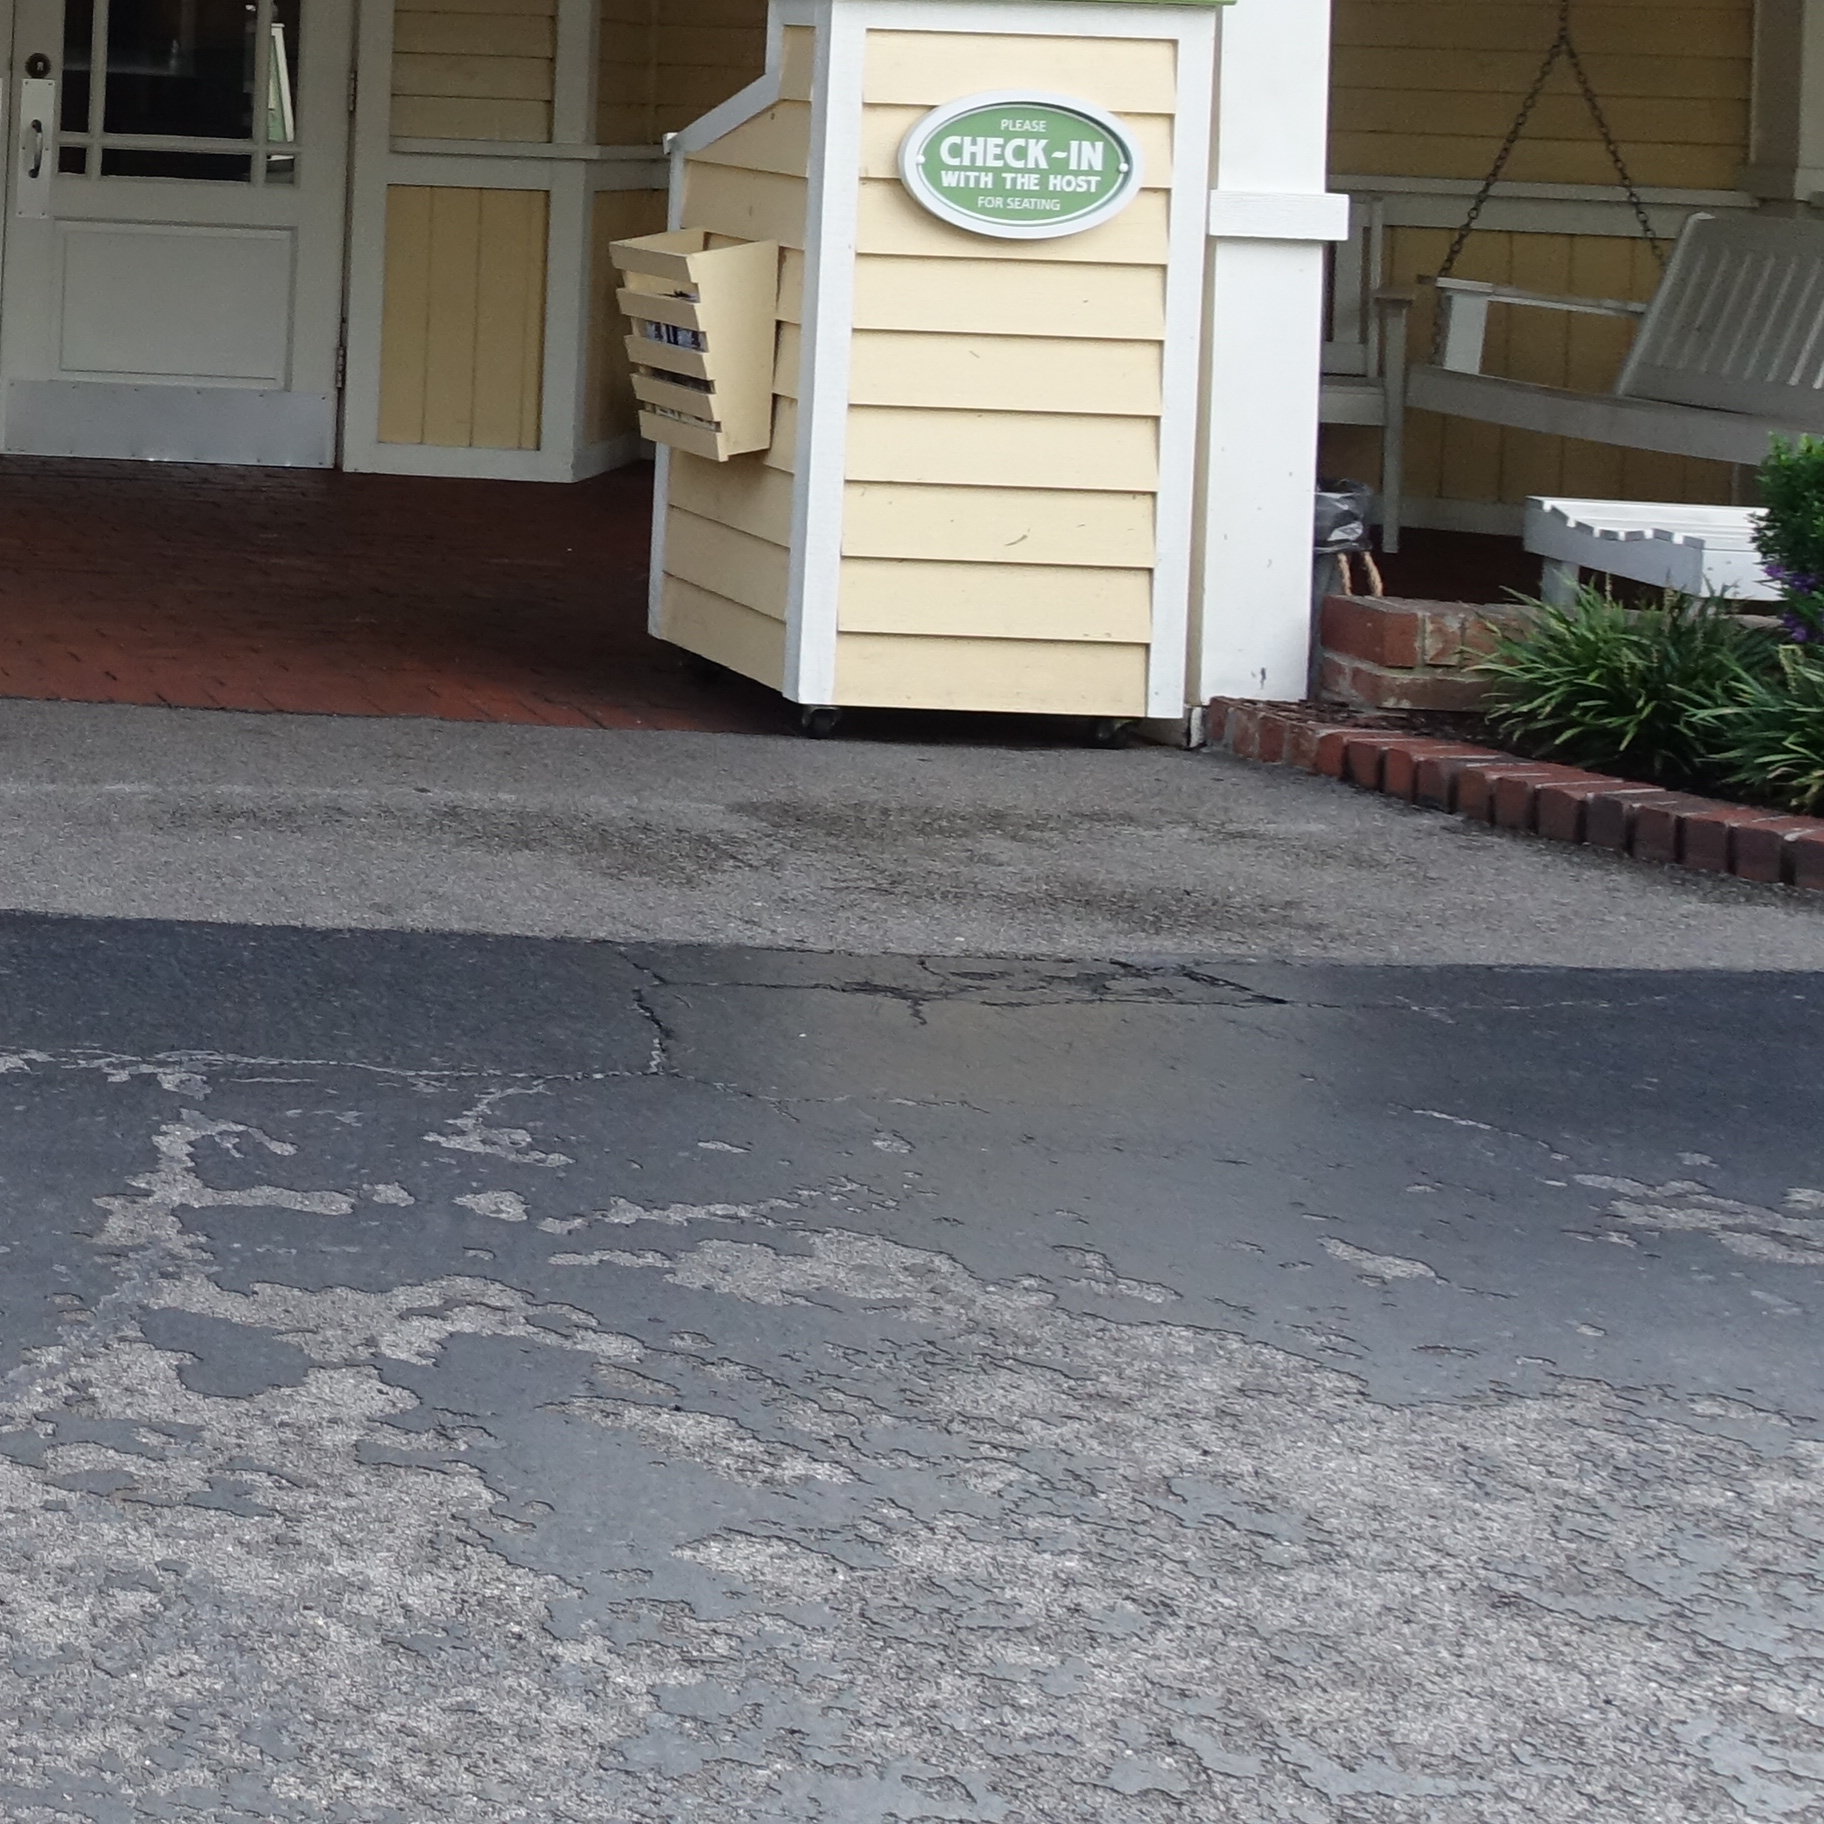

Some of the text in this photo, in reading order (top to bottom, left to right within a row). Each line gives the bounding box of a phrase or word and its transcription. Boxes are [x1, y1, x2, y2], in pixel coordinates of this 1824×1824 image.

[1000, 119, 1047, 132] PLEASE
[941, 171, 1101, 193] WITH THE HOST
[977, 196, 1061, 211] FOR SEATING
